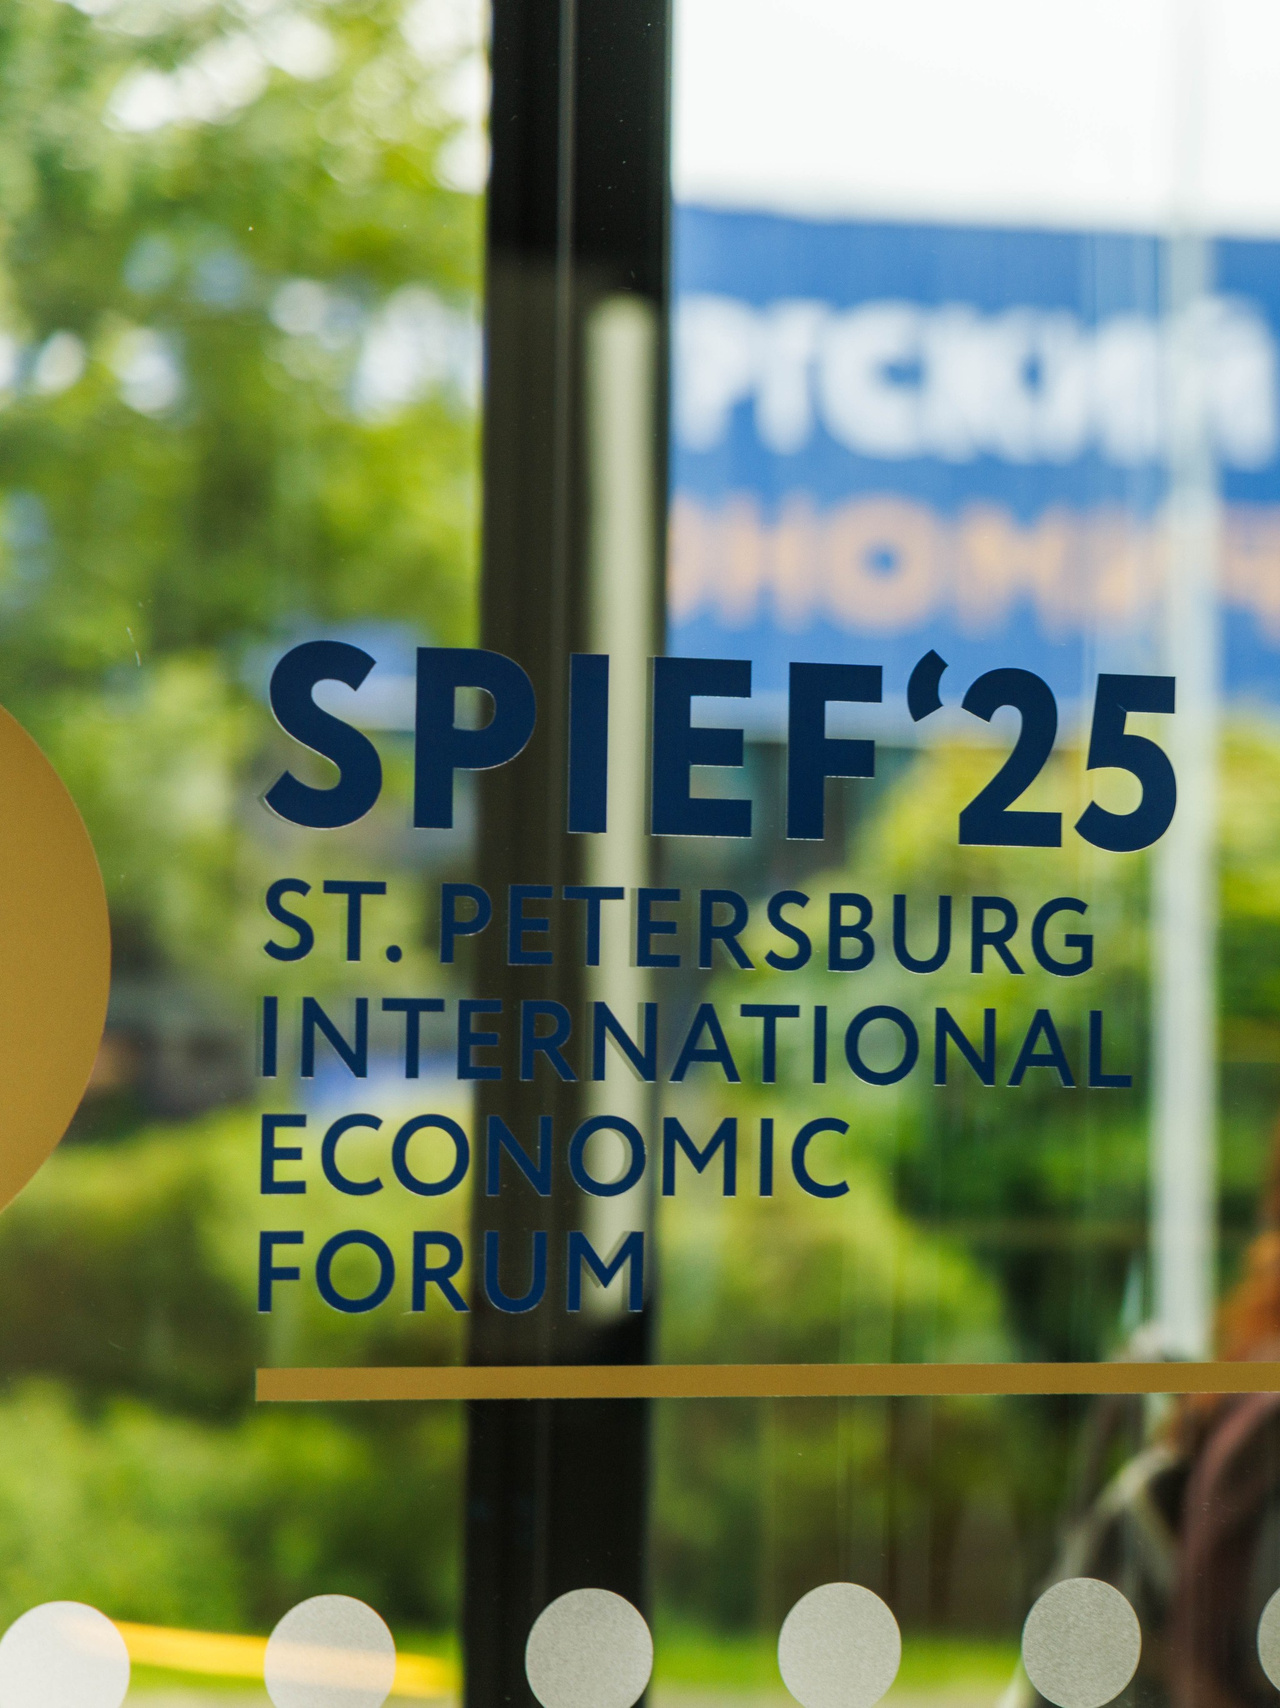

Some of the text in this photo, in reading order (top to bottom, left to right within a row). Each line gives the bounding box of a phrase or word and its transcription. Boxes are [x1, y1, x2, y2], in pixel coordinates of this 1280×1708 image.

[263, 878, 1095, 977] ST. PETERSBURG
[259, 996, 1134, 1088] INTERNATIONAL
[258, 1113, 851, 1199] ECONOMIC
[257, 1229, 647, 1314] FORUM
